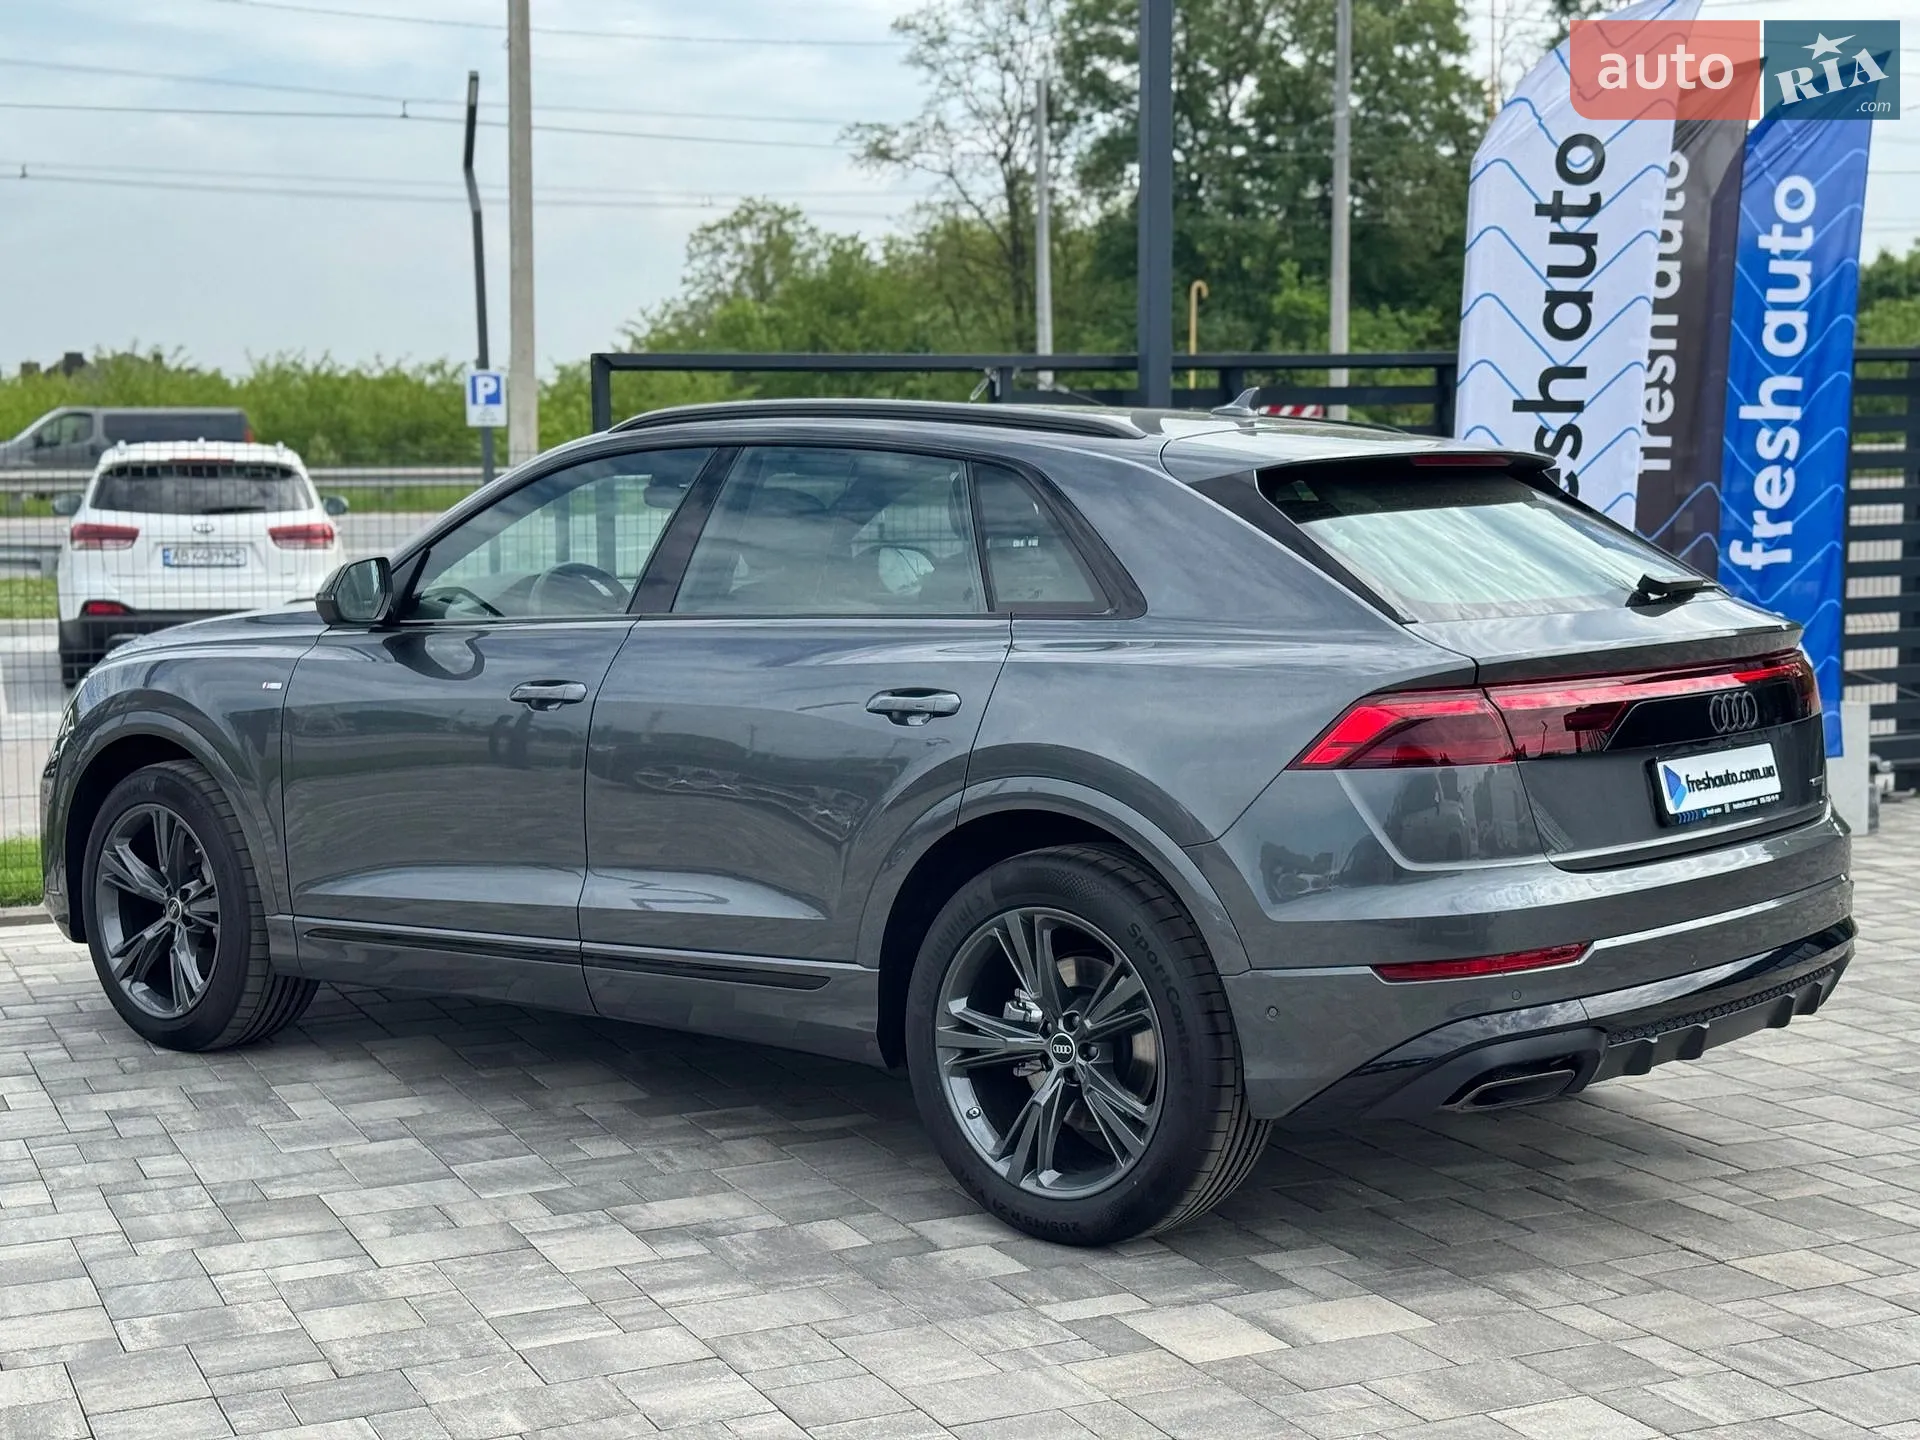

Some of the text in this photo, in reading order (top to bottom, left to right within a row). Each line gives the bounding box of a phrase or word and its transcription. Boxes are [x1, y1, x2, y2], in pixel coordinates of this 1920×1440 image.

[1534, 133, 1606, 342] auto
[476, 375, 498, 405] P
[1729, 175, 1817, 570] fresh auto
[1685, 764, 1777, 794] freshauto.com.ua
